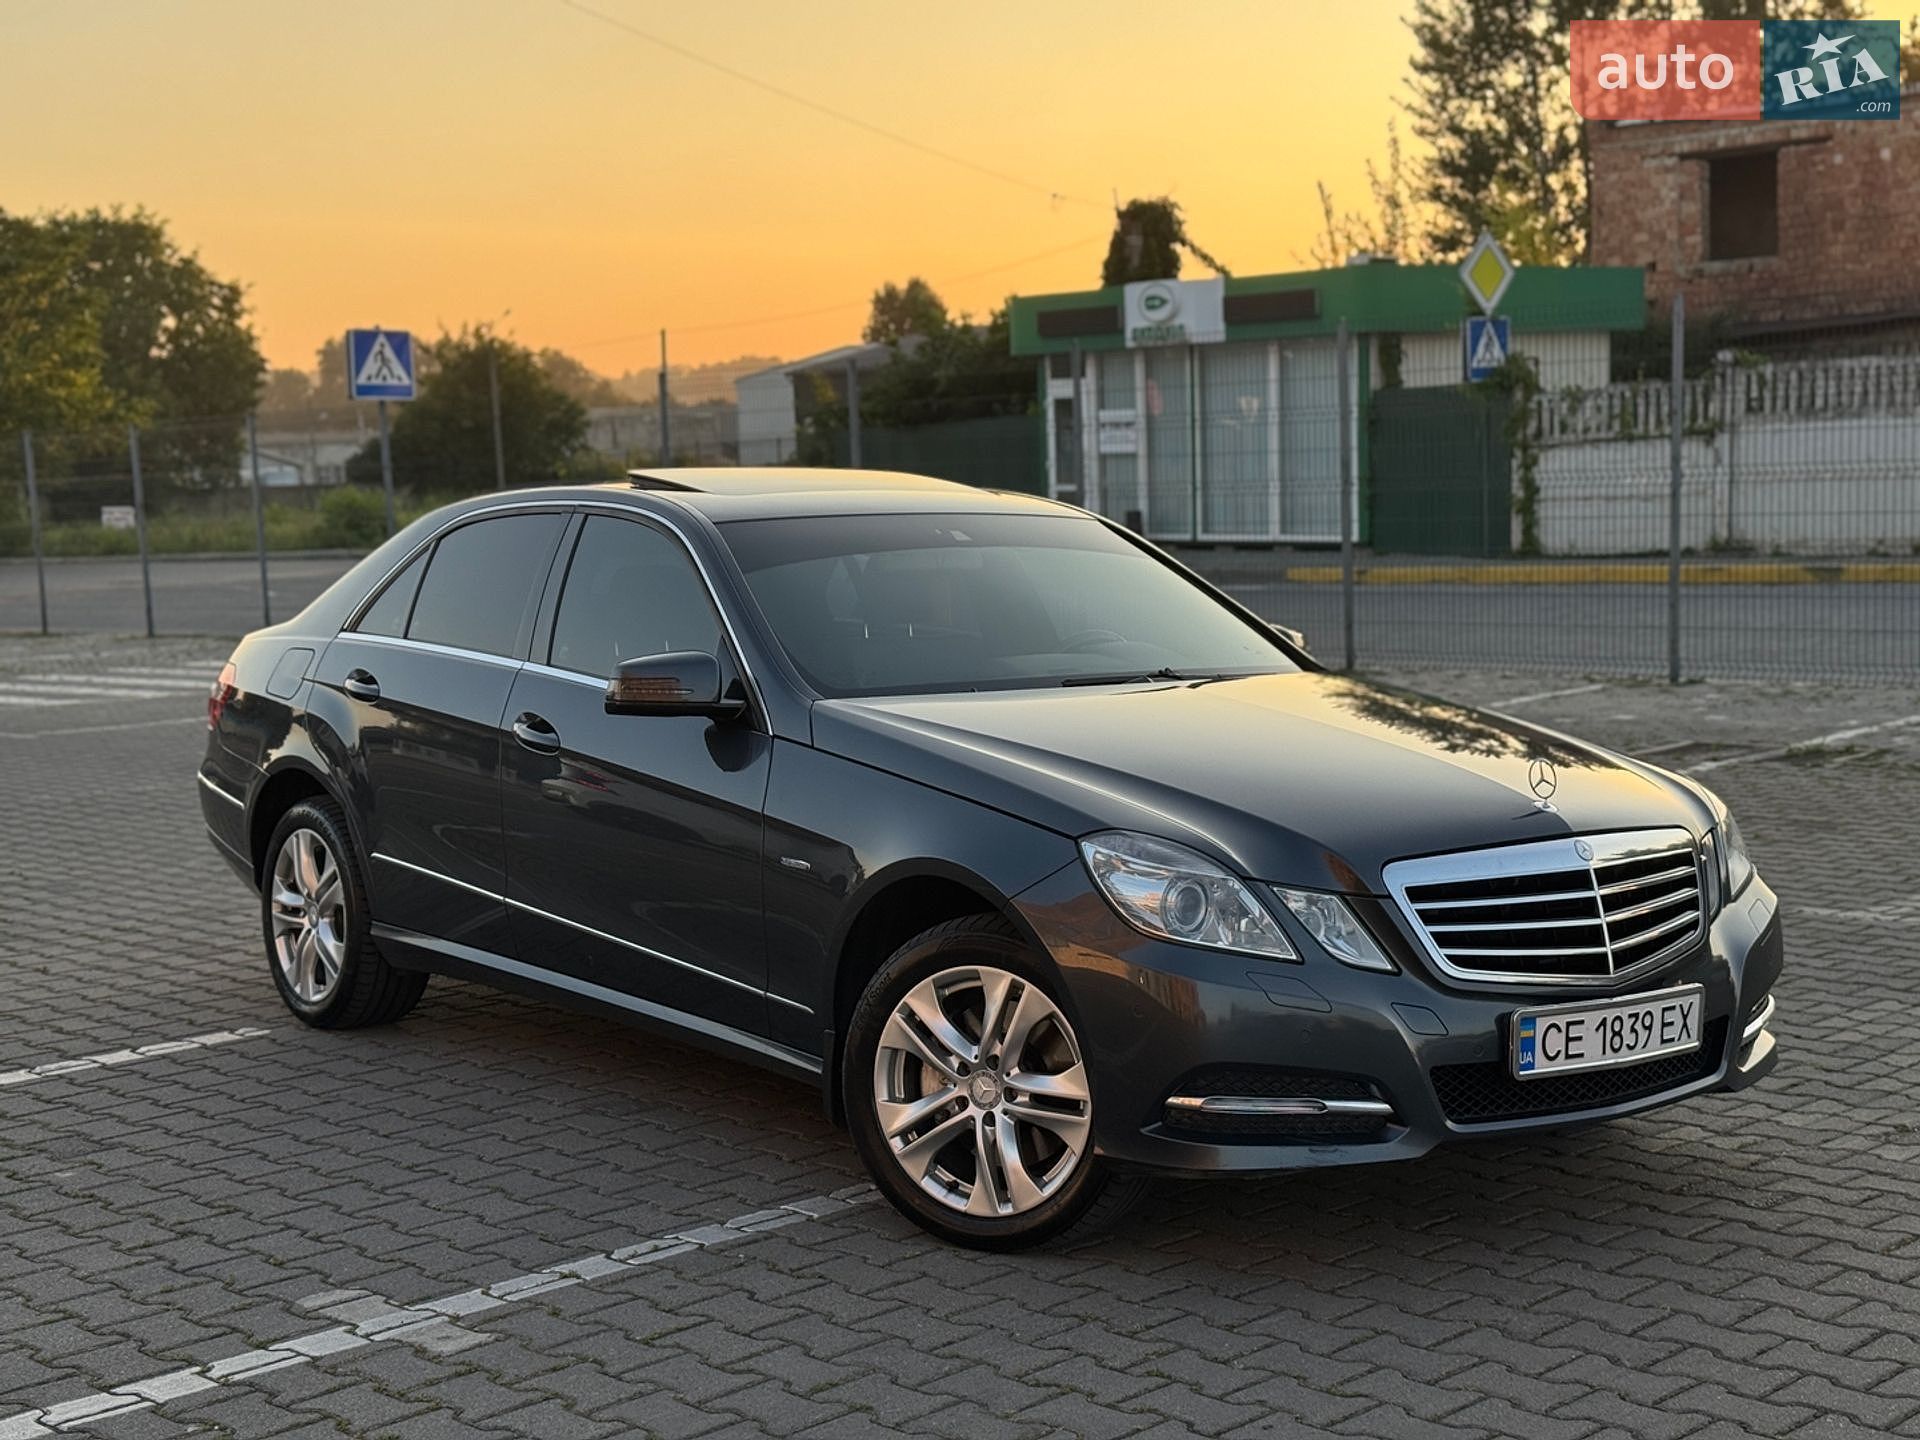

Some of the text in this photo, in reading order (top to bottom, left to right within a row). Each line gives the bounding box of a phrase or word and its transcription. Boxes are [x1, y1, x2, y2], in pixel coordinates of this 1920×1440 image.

[1541, 1001, 1693, 1062] CE 1839 EX
[1519, 1051, 1533, 1064] UA
